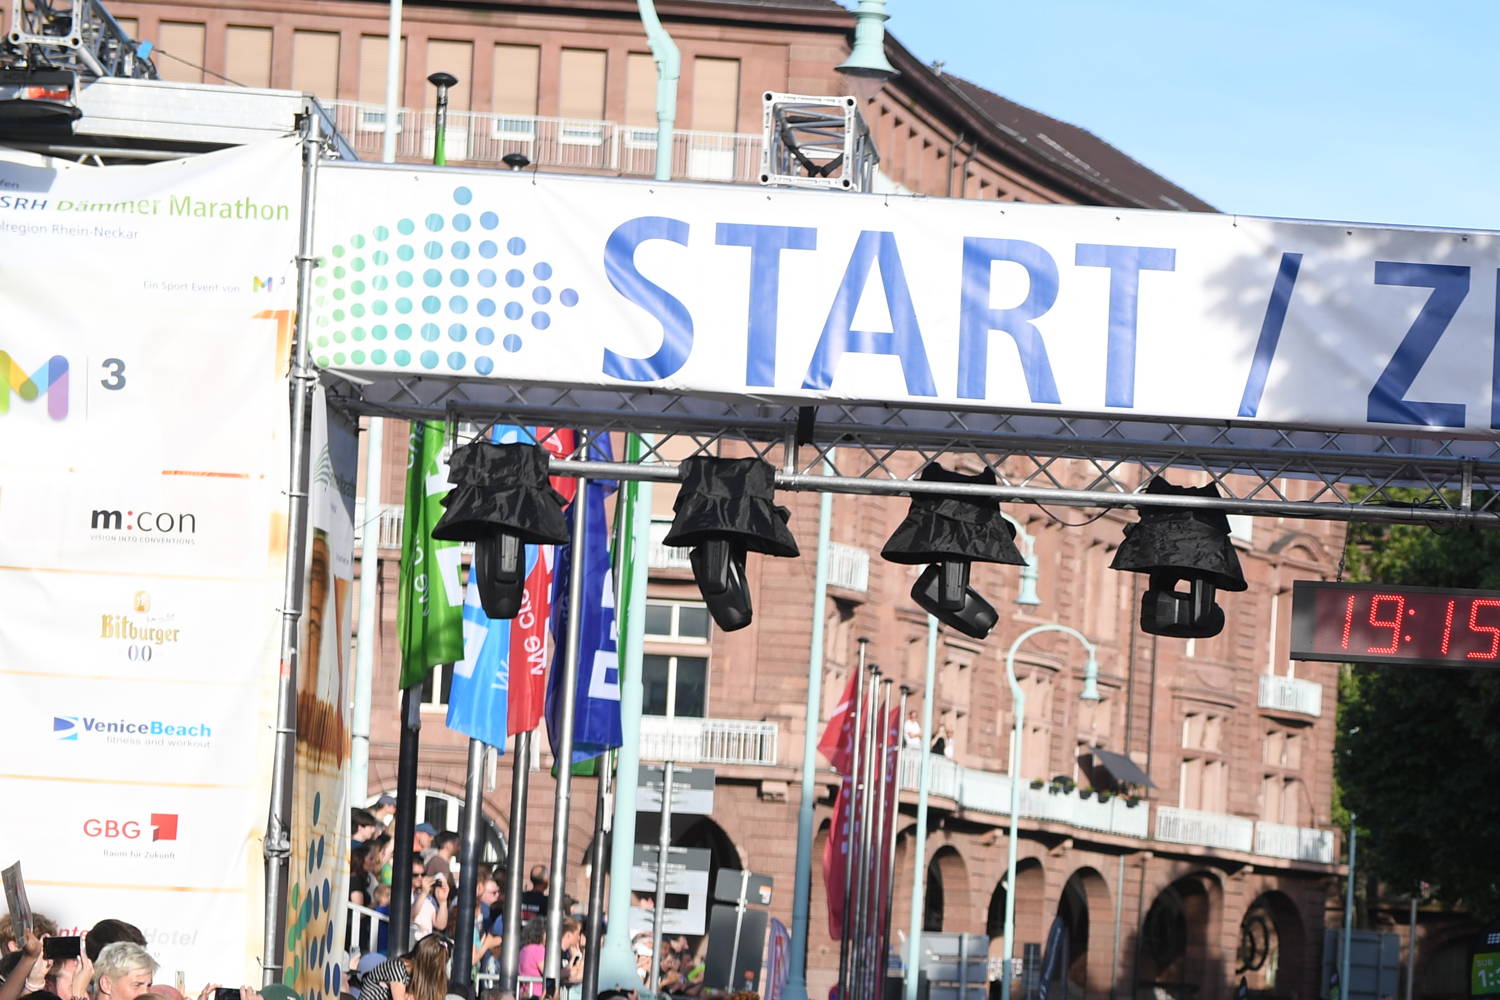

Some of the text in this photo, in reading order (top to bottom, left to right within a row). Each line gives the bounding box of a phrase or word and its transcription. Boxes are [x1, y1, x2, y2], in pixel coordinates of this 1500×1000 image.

[56, 198, 161, 215] Dämmer
[168, 194, 290, 221] Marathon
[0, 220, 138, 240] lregion Rhein-Neckar
[602, 215, 1176, 408] START
[1237, 252, 1303, 418] /
[100, 358, 127, 390] 3
[100, 614, 180, 645] Bitburger
[83, 818, 141, 840] GBG
